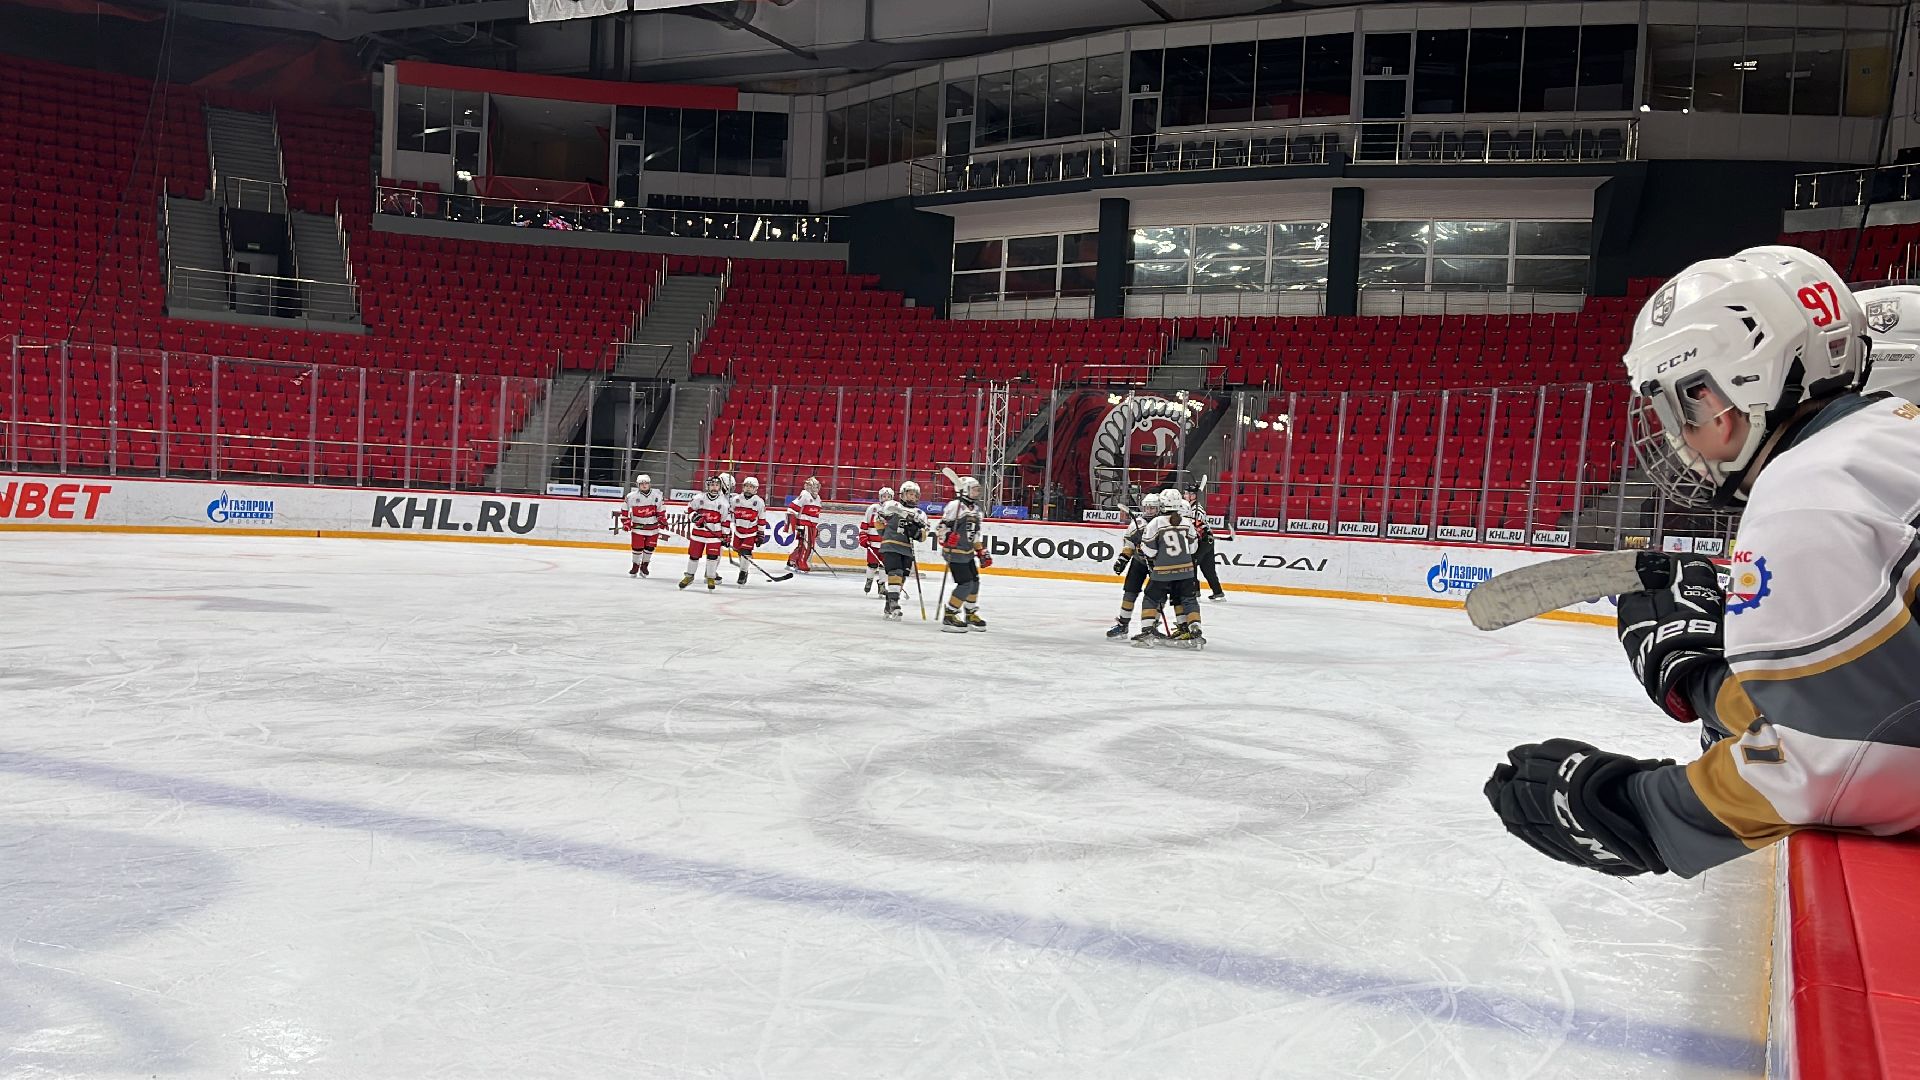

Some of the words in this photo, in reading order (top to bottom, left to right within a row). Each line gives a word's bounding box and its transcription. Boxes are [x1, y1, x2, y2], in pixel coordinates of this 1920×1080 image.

[1797, 281, 1842, 328] 97
[1657, 348, 1698, 374] CCM
[1870, 353, 1916, 362] AUER
[675, 492, 699, 500] PAR
[229, 500, 274, 512] ГАЗПРОМ
[371, 495, 540, 535] KHL.RU
[1085, 510, 1119, 521] KHL.RU
[1239, 517, 1276, 529] KHL.RU
[1290, 521, 1326, 532] KHL.RU
[1340, 525, 1376, 535] KHL.RU
[1389, 525, 1425, 537] KHL.RU
[1439, 527, 1474, 539] KHL.RU
[1488, 531, 1523, 542] KHL.RU
[1534, 532, 1568, 544] KHL.RU
[927, 531, 1115, 563] ТЬКОФФ
[1163, 530, 1191, 558] 91
[1695, 540, 1722, 552] KHL.RU
[1213, 552, 1329, 572] ALDAI
[1449, 565, 1493, 582] ГАЗПРОМ
[1450, 580, 1477, 589] ТРАНС
[1553, 752, 1622, 862] CCM
